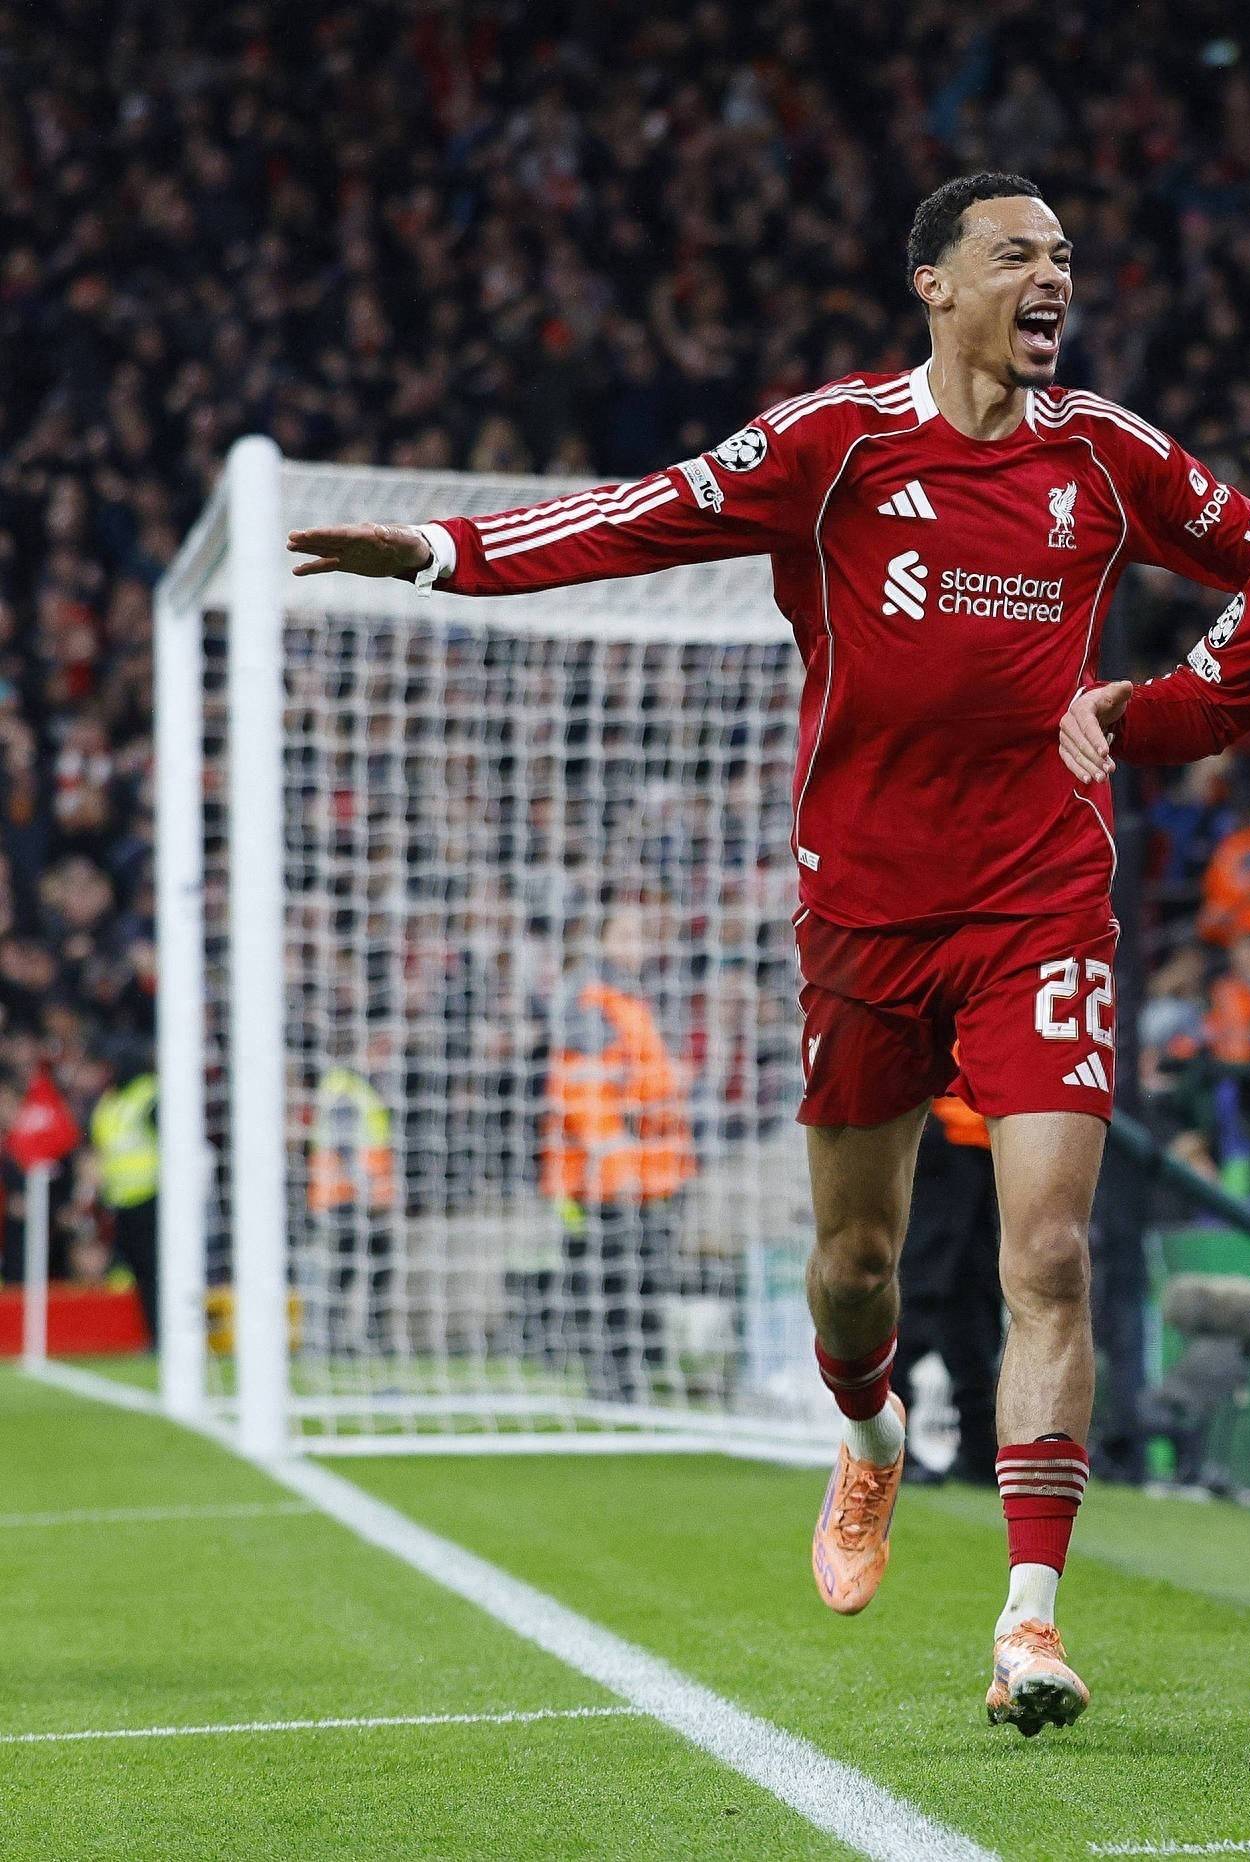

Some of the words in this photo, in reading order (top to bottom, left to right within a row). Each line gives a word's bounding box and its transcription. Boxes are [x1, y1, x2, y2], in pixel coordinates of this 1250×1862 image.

[940, 567, 1063, 600] standard
[938, 590, 1064, 623] chartered
[1035, 956, 1115, 1050] 22
